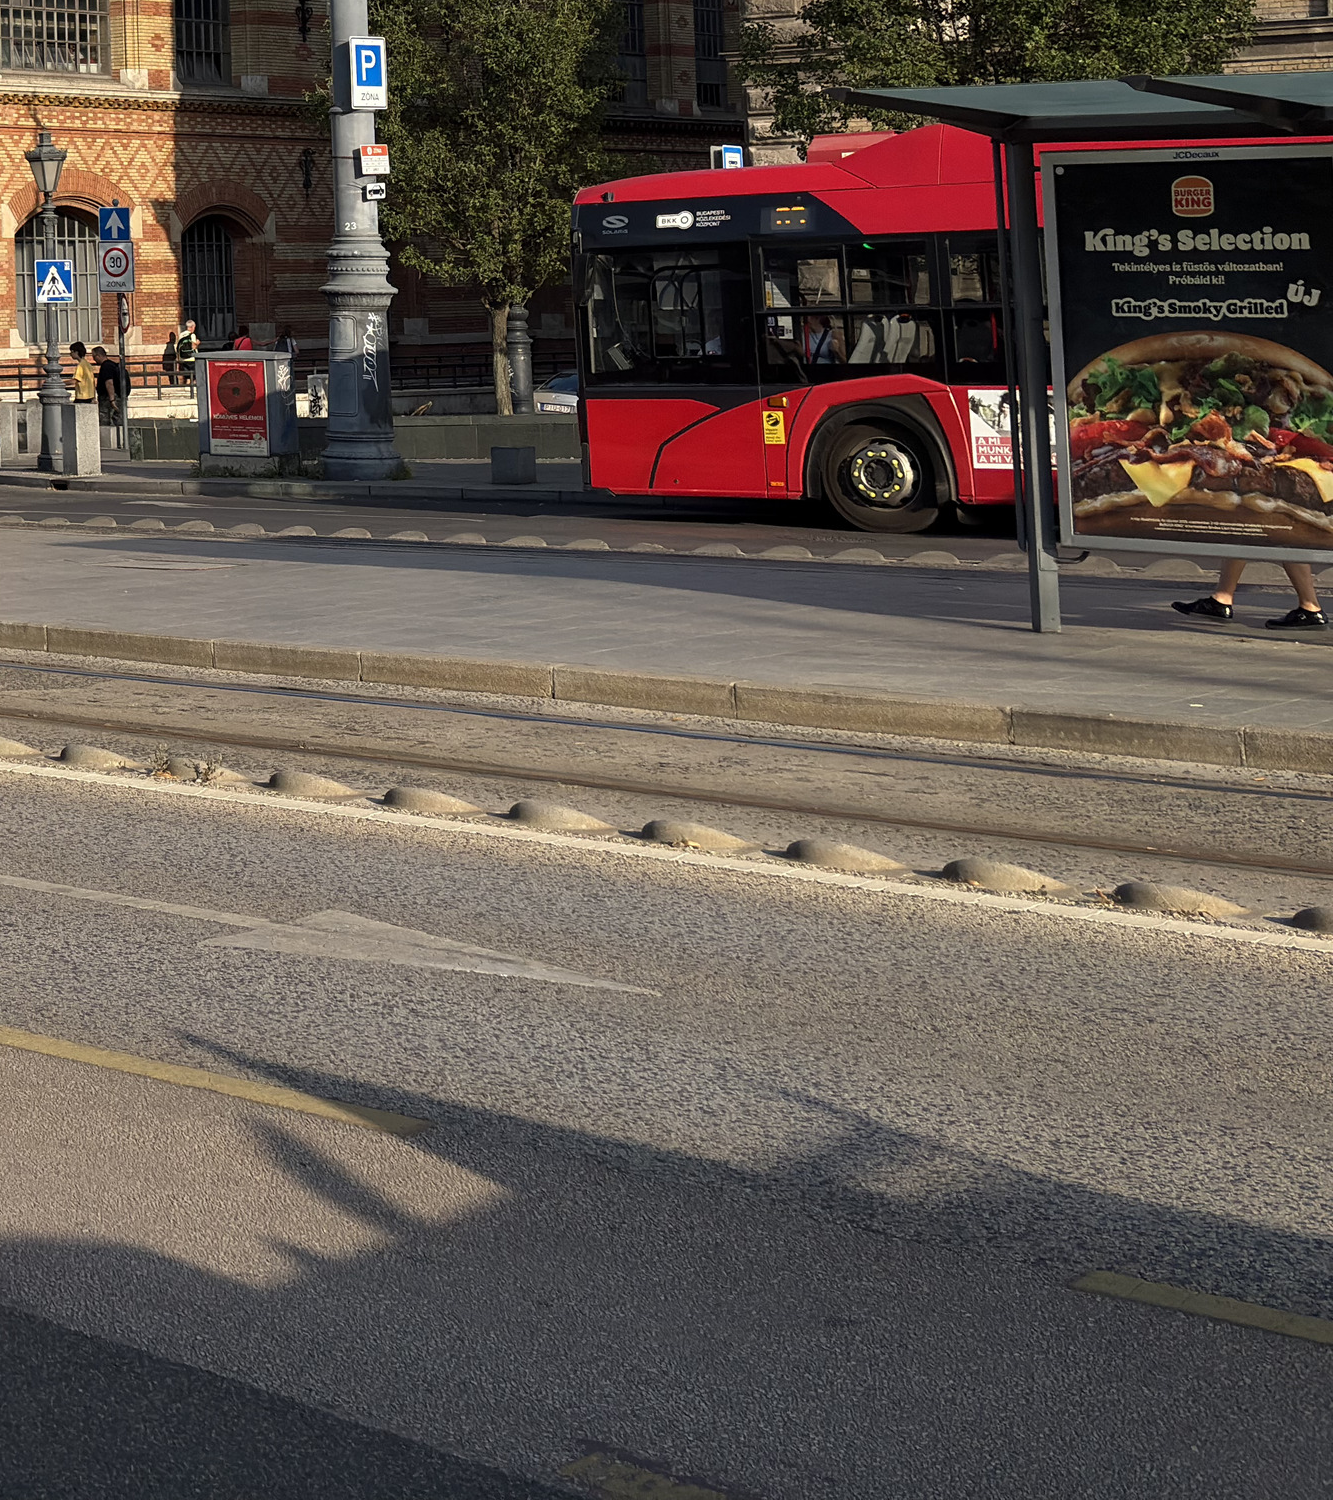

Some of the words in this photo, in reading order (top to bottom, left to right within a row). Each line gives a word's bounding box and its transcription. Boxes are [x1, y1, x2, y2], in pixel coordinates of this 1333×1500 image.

[361, 49, 376, 81] P
[1173, 151, 1219, 160] JCDecaux
[1174, 189, 1211, 197] BURGER
[1174, 197, 1212, 209] KING
[345, 222, 357, 230] 23
[1084, 228, 1172, 257] King's
[1177, 226, 1311, 251] Selection
[110, 257, 121, 268] 30
[1112, 262, 1170, 274] Tekintélyes
[1172, 262, 1181, 272] íz
[1183, 262, 1216, 272] füstös
[1217, 262, 1284, 272] változatban!
[1168, 275, 1210, 285] Próbáld
[1212, 275, 1225, 285] ki!
[1286, 279, 1321, 307] ÚJ
[1114, 301, 1165, 318] King's
[1168, 301, 1222, 318] Smoky
[1226, 300, 1284, 315] Grilled
[978, 446, 1012, 454] MUNK
